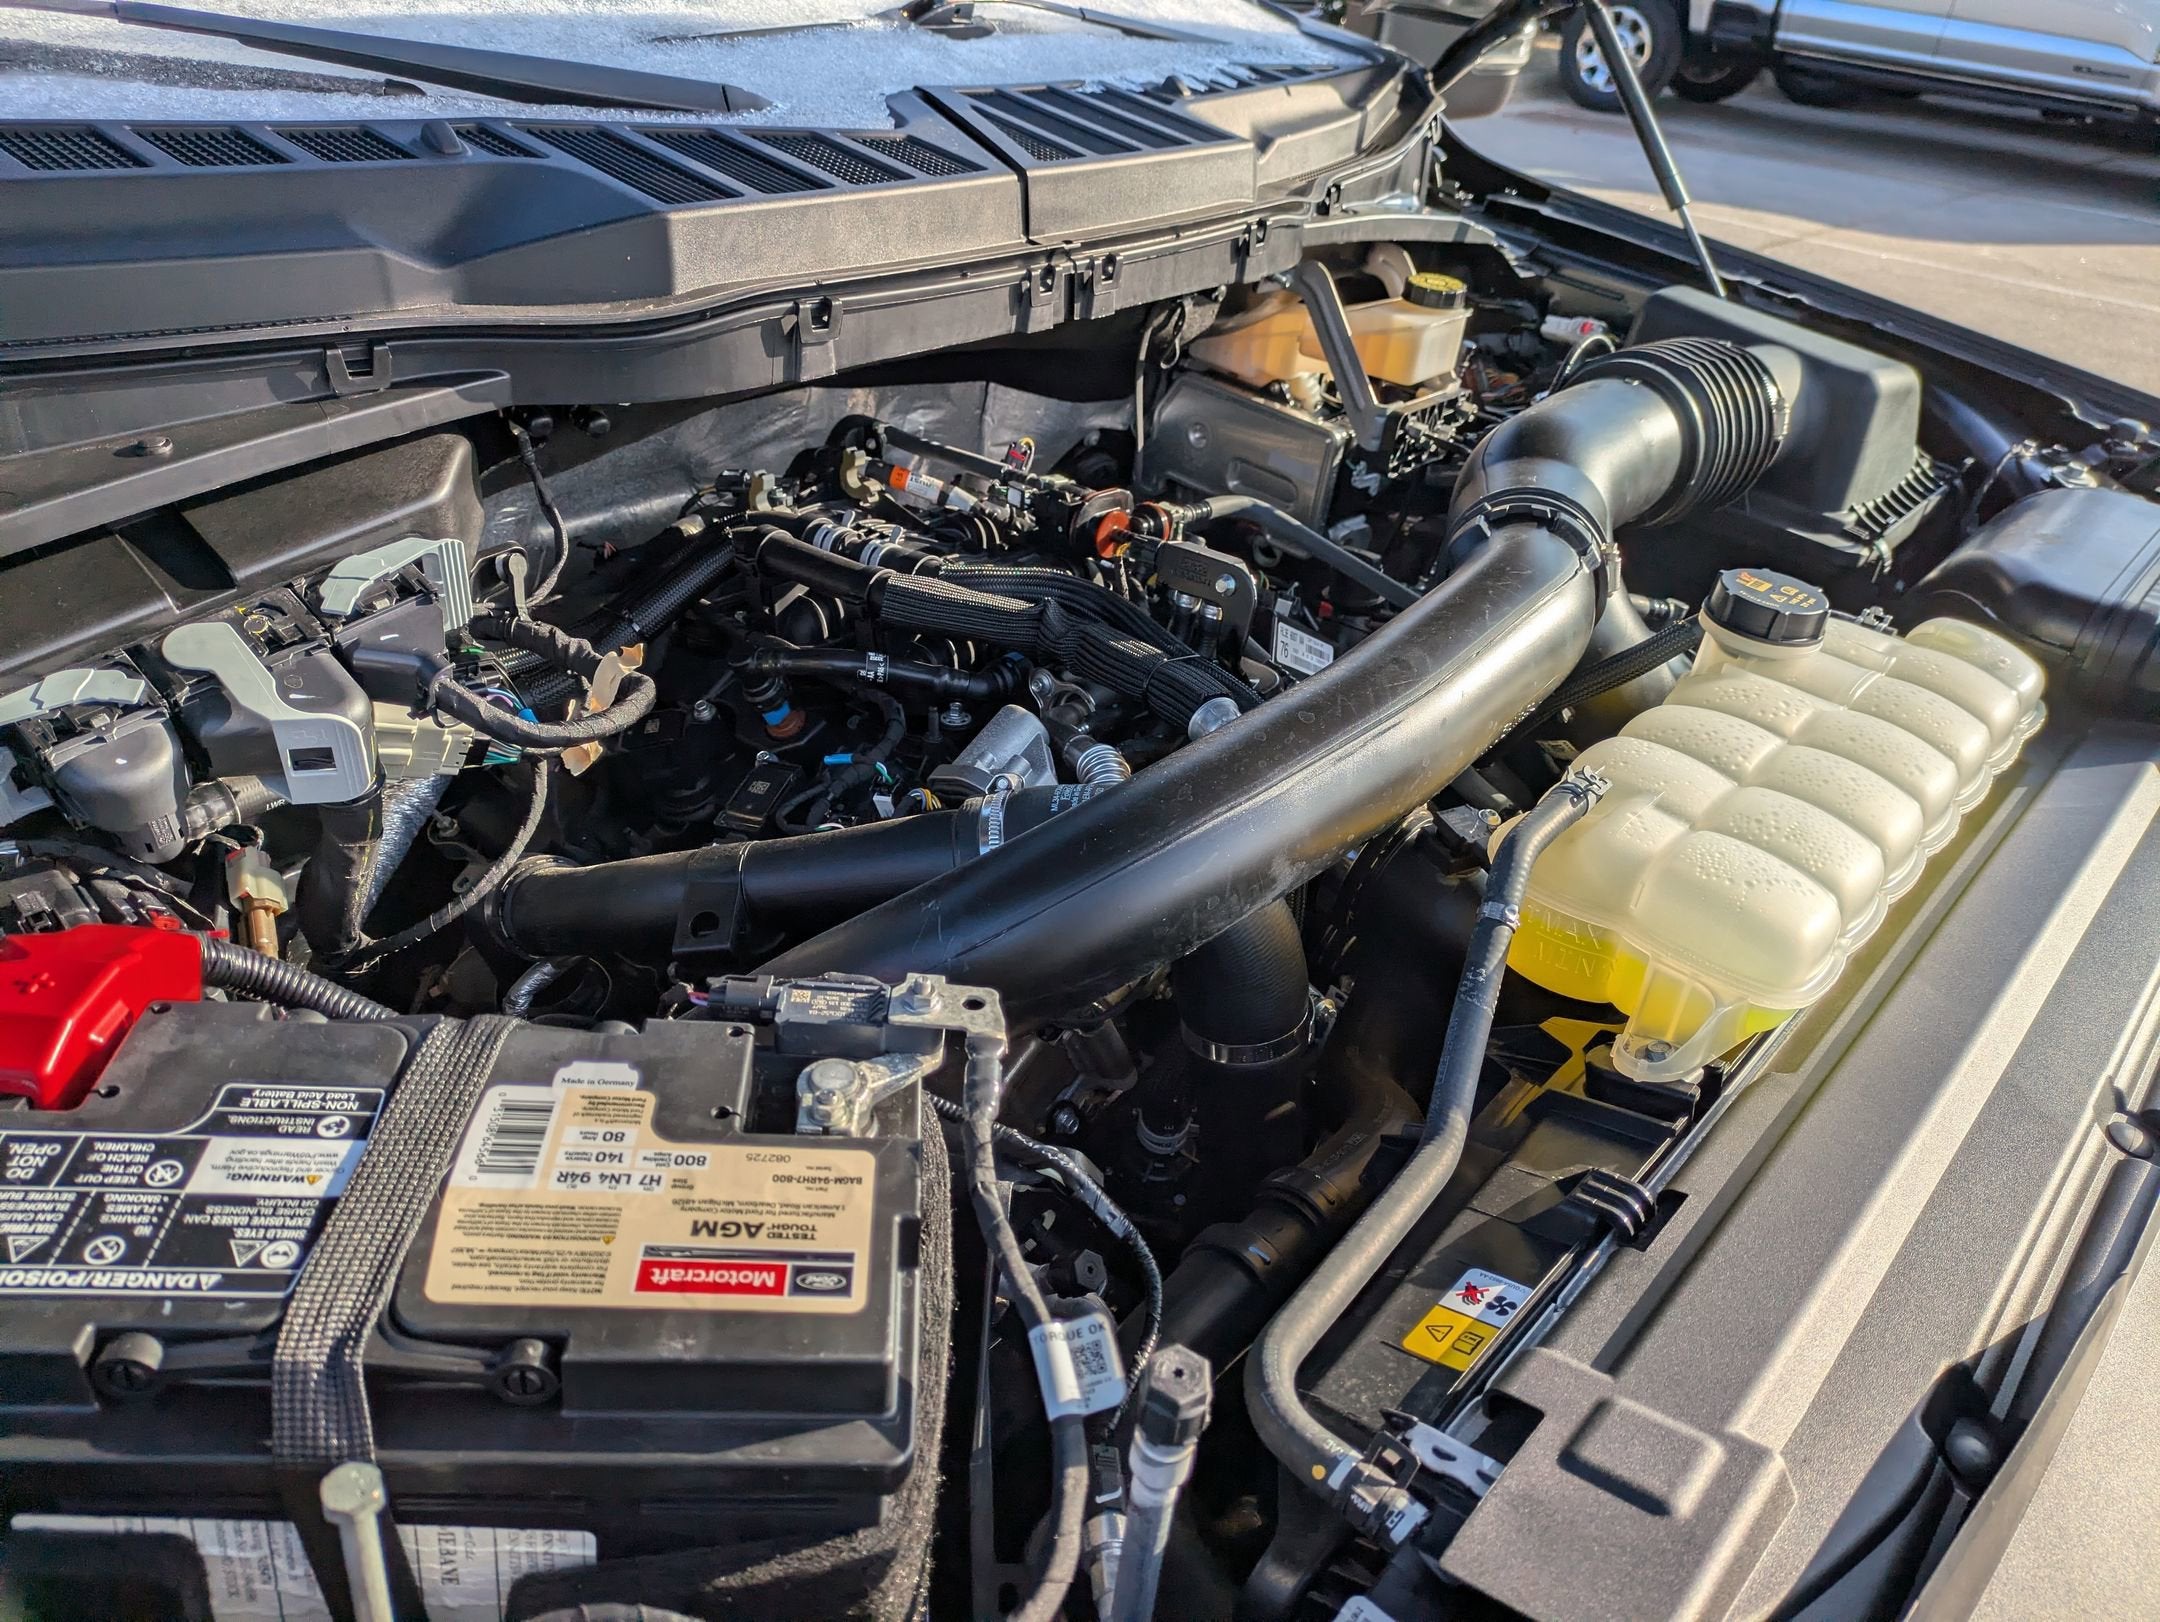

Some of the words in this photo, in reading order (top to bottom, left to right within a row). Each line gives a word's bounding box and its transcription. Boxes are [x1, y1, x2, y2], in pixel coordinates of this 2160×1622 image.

[1280, 640, 1289, 658] 76
[266, 799, 285, 811] LWR
[598, 1078, 633, 1087] Germany
[252, 1089, 295, 1099] Battery
[297, 1091, 324, 1099] Acid
[325, 1092, 356, 1100] Lead
[240, 1097, 358, 1110] NON-SPILLABLE
[228, 1115, 315, 1125] INSTRUCTIONS.
[278, 1126, 311, 1134] READ
[602, 1131, 625, 1142] 80
[9, 1143, 61, 1155] OPEN.
[93, 1142, 155, 1152] CHILDREN.
[7, 1155, 48, 1167] NOT
[87, 1153, 106, 1161] OF
[108, 1154, 150, 1162] REACH
[595, 1152, 623, 1163] 140
[674, 1155, 707, 1166] 800
[746, 1153, 791, 1163] 082725
[100, 1164, 125, 1172] THE
[126, 1165, 144, 1173] OF
[238, 1165, 294, 1173] Reproductive
[6, 1168, 35, 1179] DO
[74, 1174, 102, 1183] OUT
[226, 1173, 306, 1184] WARNING:
[557, 1172, 591, 1183] 94R
[598, 1173, 632, 1184] LN4
[105, 1176, 138, 1184] KEEP
[638, 1175, 662, 1186] H7
[772, 1175, 862, 1185] BAGM-94RH7-800
[26, 1192, 77, 1201] SEVERE
[104, 1193, 162, 1202] SMOKING
[256, 1198, 299, 1207] INJURY.
[300, 1199, 319, 1207] OR
[698, 1198, 734, 1207] Michigan
[737, 1200, 776, 1208] Dearborn,
[779, 1201, 801, 1209] Road,
[803, 1202, 841, 1210] American
[106, 1204, 156, 1213] FLAMES
[205, 1205, 273, 1216] BLINDNESS
[275, 1207, 315, 1216] CAUSE
[35, 1212, 64, 1221] CAN
[100, 1214, 152, 1223] SPARKS
[184, 1214, 210, 1224] CAN
[778, 1210, 835, 1218] Manufactured
[212, 1215, 249, 1226] GASES
[250, 1216, 312, 1227] EXPLOSIVE
[133, 1225, 153, 1237] NO
[233, 1228, 265, 1238] EYES.
[266, 1228, 307, 1240] SHIELD
[690, 1220, 764, 1238] AGM
[767, 1232, 816, 1240] TESTED
[650, 1268, 775, 1288] Motorcraft
[805, 1274, 839, 1288] Ford
[1088, 1321, 1107, 1335] OK
